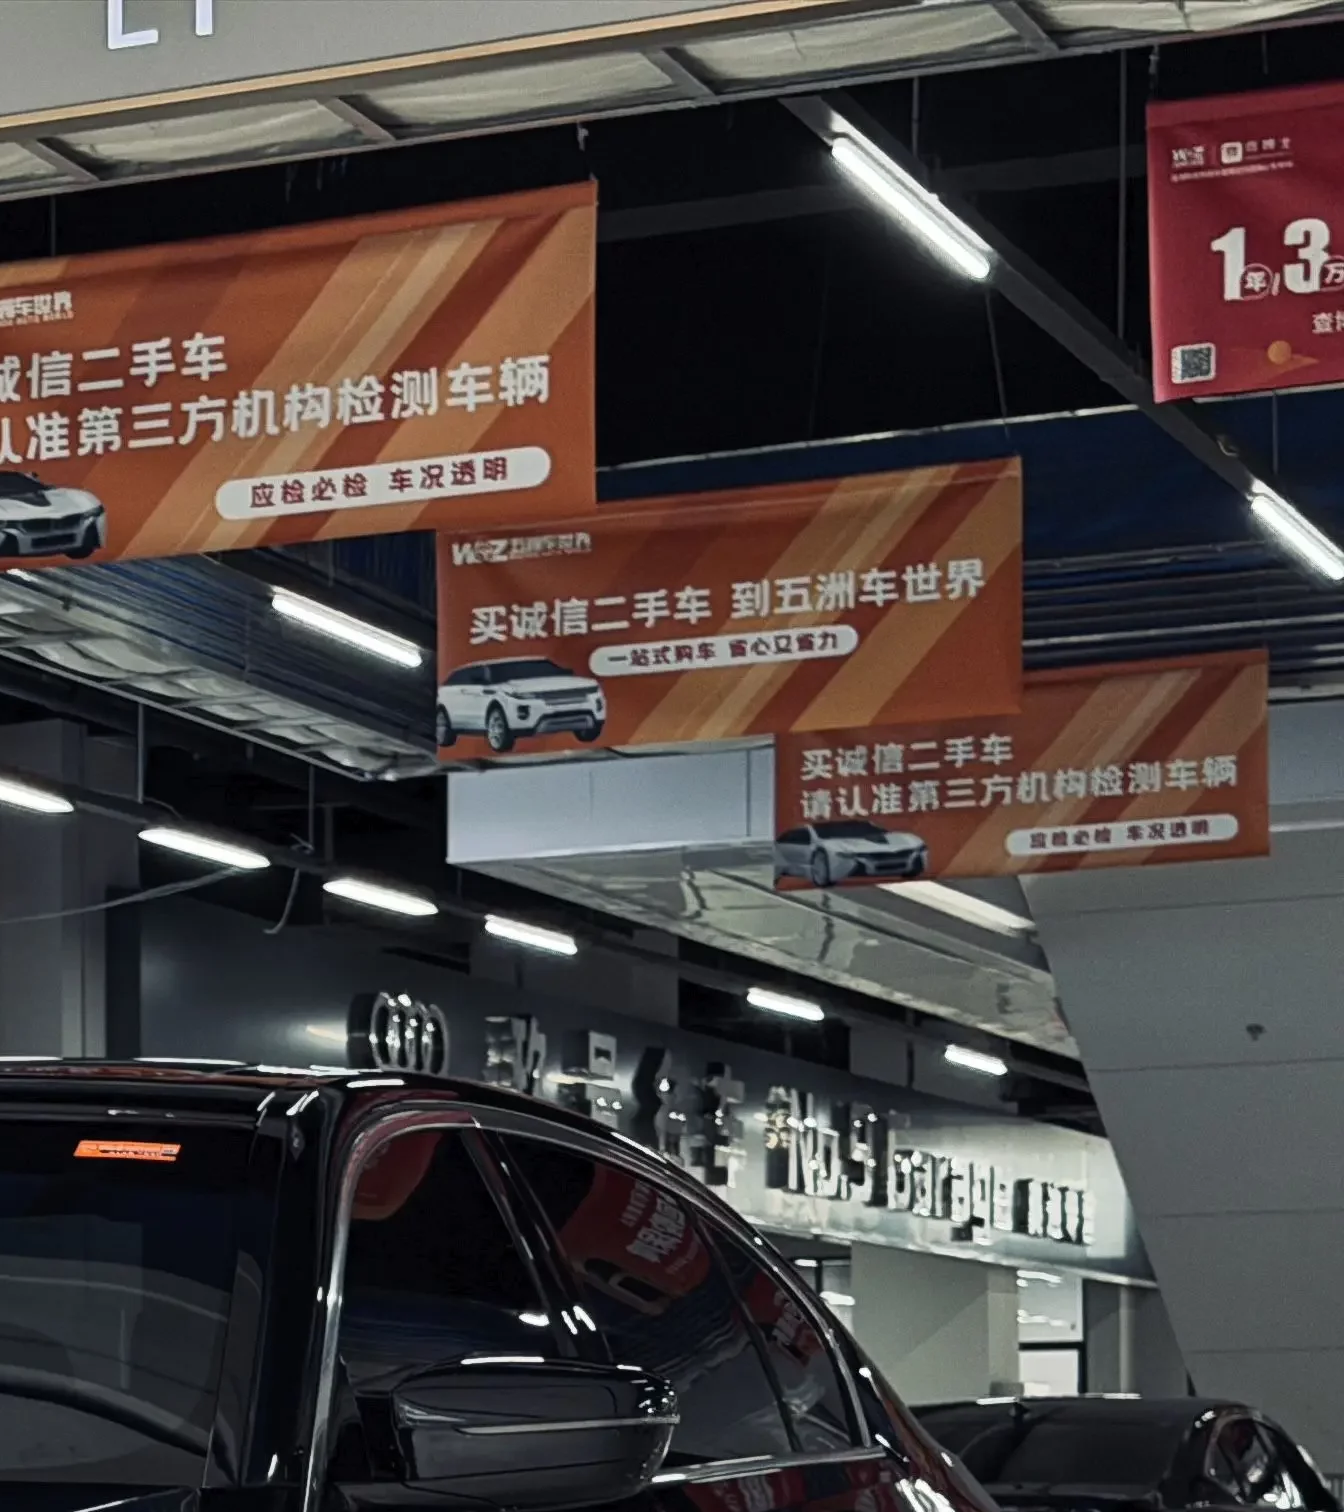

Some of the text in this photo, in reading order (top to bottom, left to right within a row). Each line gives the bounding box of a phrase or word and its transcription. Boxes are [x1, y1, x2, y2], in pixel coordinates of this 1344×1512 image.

[388, 456, 508, 493] 车况透明
[469, 558, 986, 645] 买诚信二手车 到五洲车世界
[799, 733, 1014, 782] 买诚信二手车
[799, 754, 1238, 820] 请认准第三方机构检测车辆
